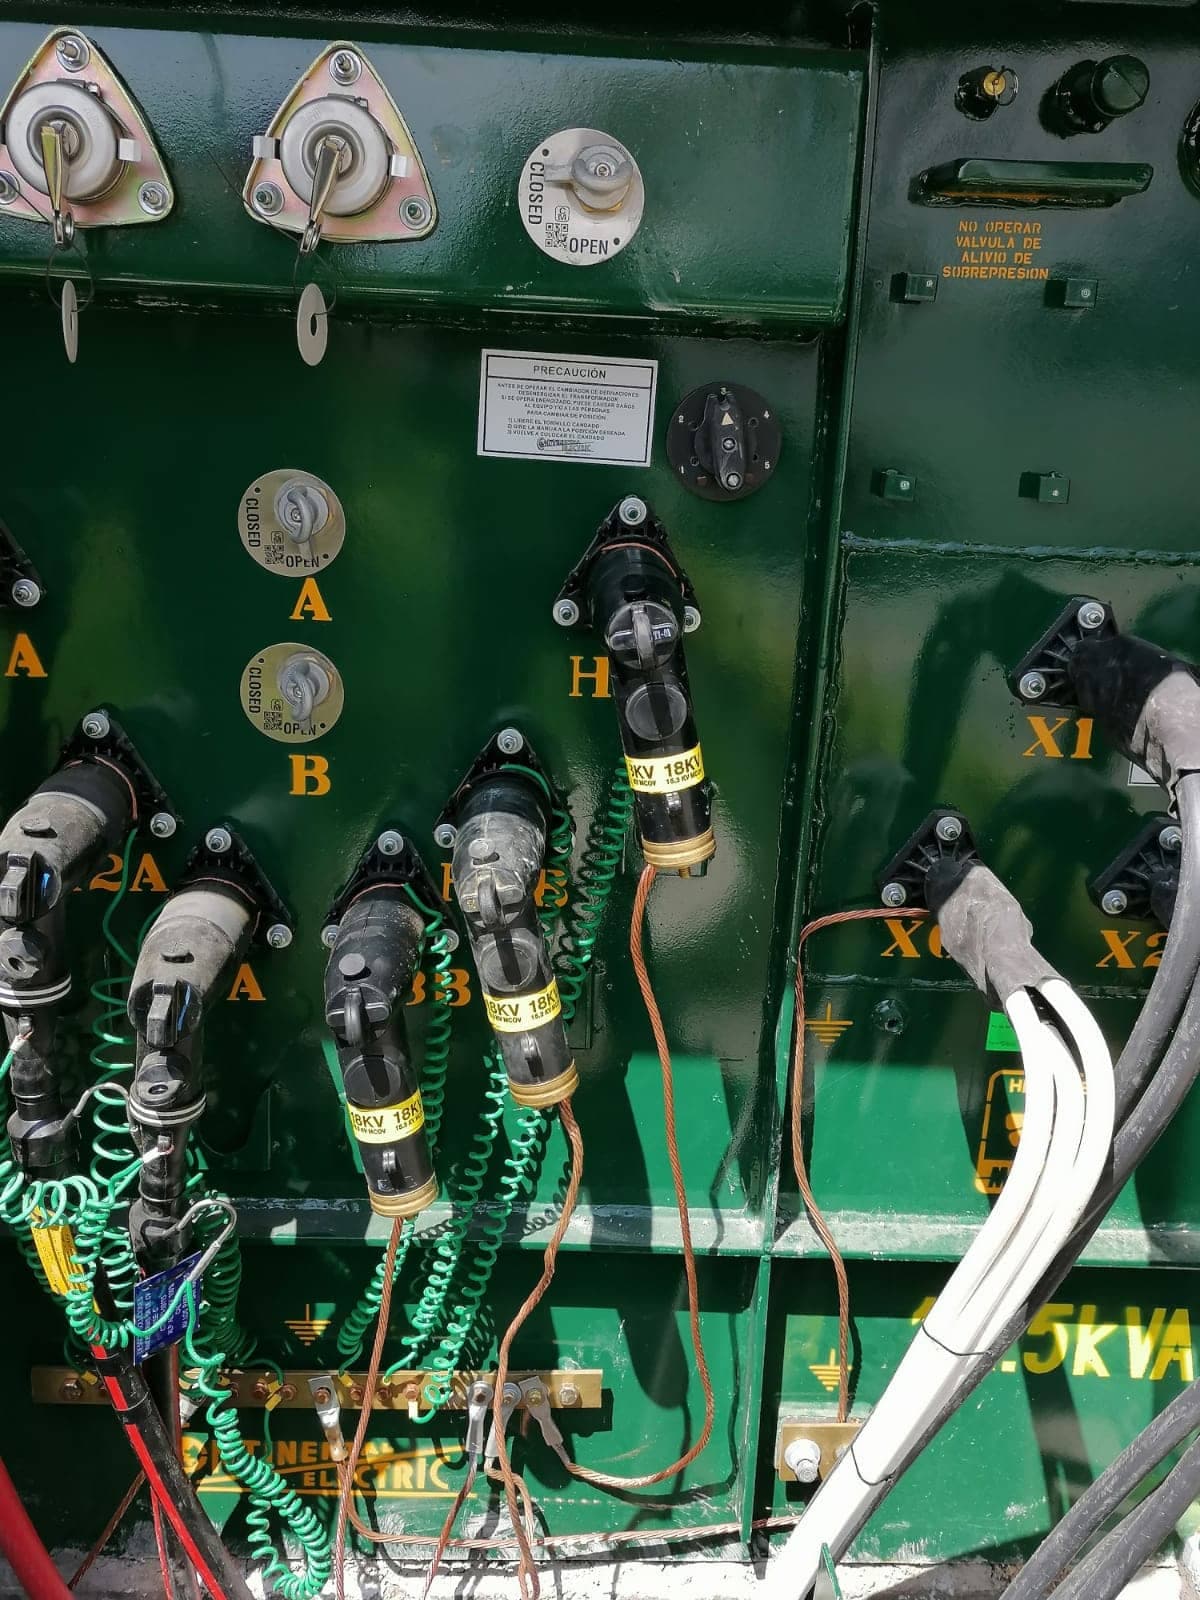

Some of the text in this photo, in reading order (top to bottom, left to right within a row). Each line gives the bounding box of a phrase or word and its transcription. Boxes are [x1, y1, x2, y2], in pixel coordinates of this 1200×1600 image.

[528, 161, 545, 225] CLOSED
[959, 221, 1042, 235] NO OPERAR
[569, 237, 608, 255] OPEN
[956, 236, 1042, 250] VALVULA DE
[961, 251, 1033, 265] ALIVIO DE
[942, 266, 1049, 280] SOBREPRESION
[533, 365, 606, 379] PRECAUCIÓN
[678, 415, 684, 423] 2
[763, 410, 770, 419] 4
[764, 461, 771, 470] 5
[246, 498, 261, 548] CLOSED
[285, 555, 320, 568] OPEN
[288, 577, 333, 621] A
[249, 667, 261, 713] CLOSED
[1022, 715, 1093, 759] X1
[288, 754, 332, 796] B
[303, 1455, 449, 1490] ELCTRIC
